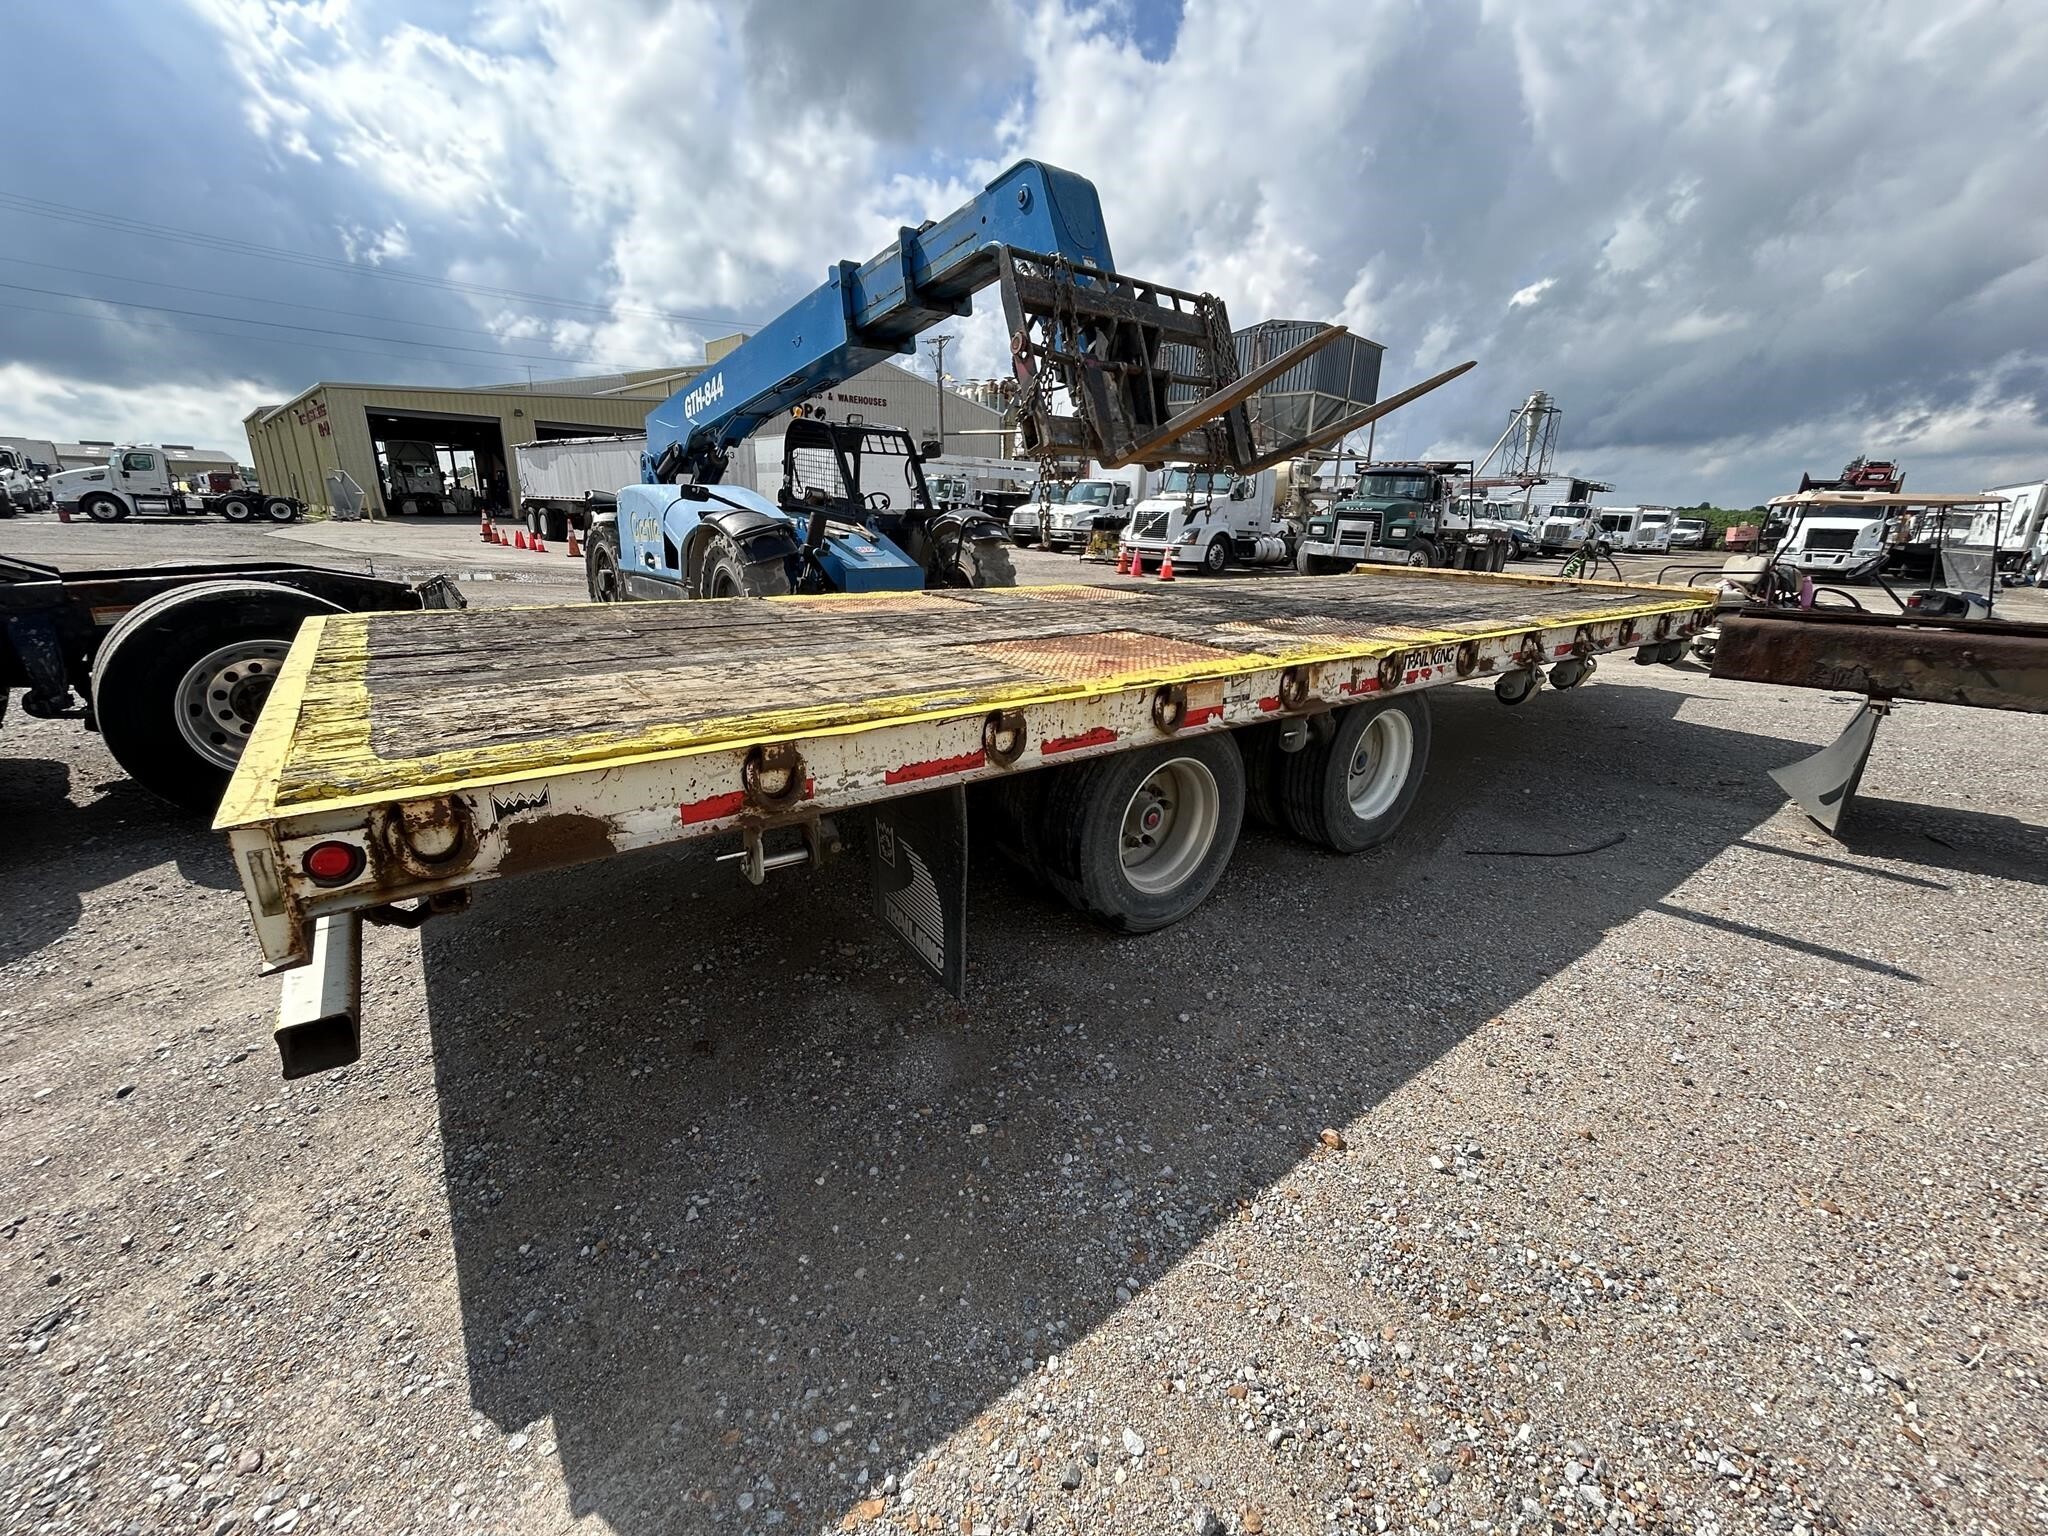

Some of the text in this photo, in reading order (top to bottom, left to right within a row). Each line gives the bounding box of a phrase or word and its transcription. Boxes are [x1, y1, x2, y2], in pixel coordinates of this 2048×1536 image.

[684, 371, 724, 419] GTH-844
[837, 393, 888, 408] WAREHOUSES
[630, 511, 662, 543] Genie
